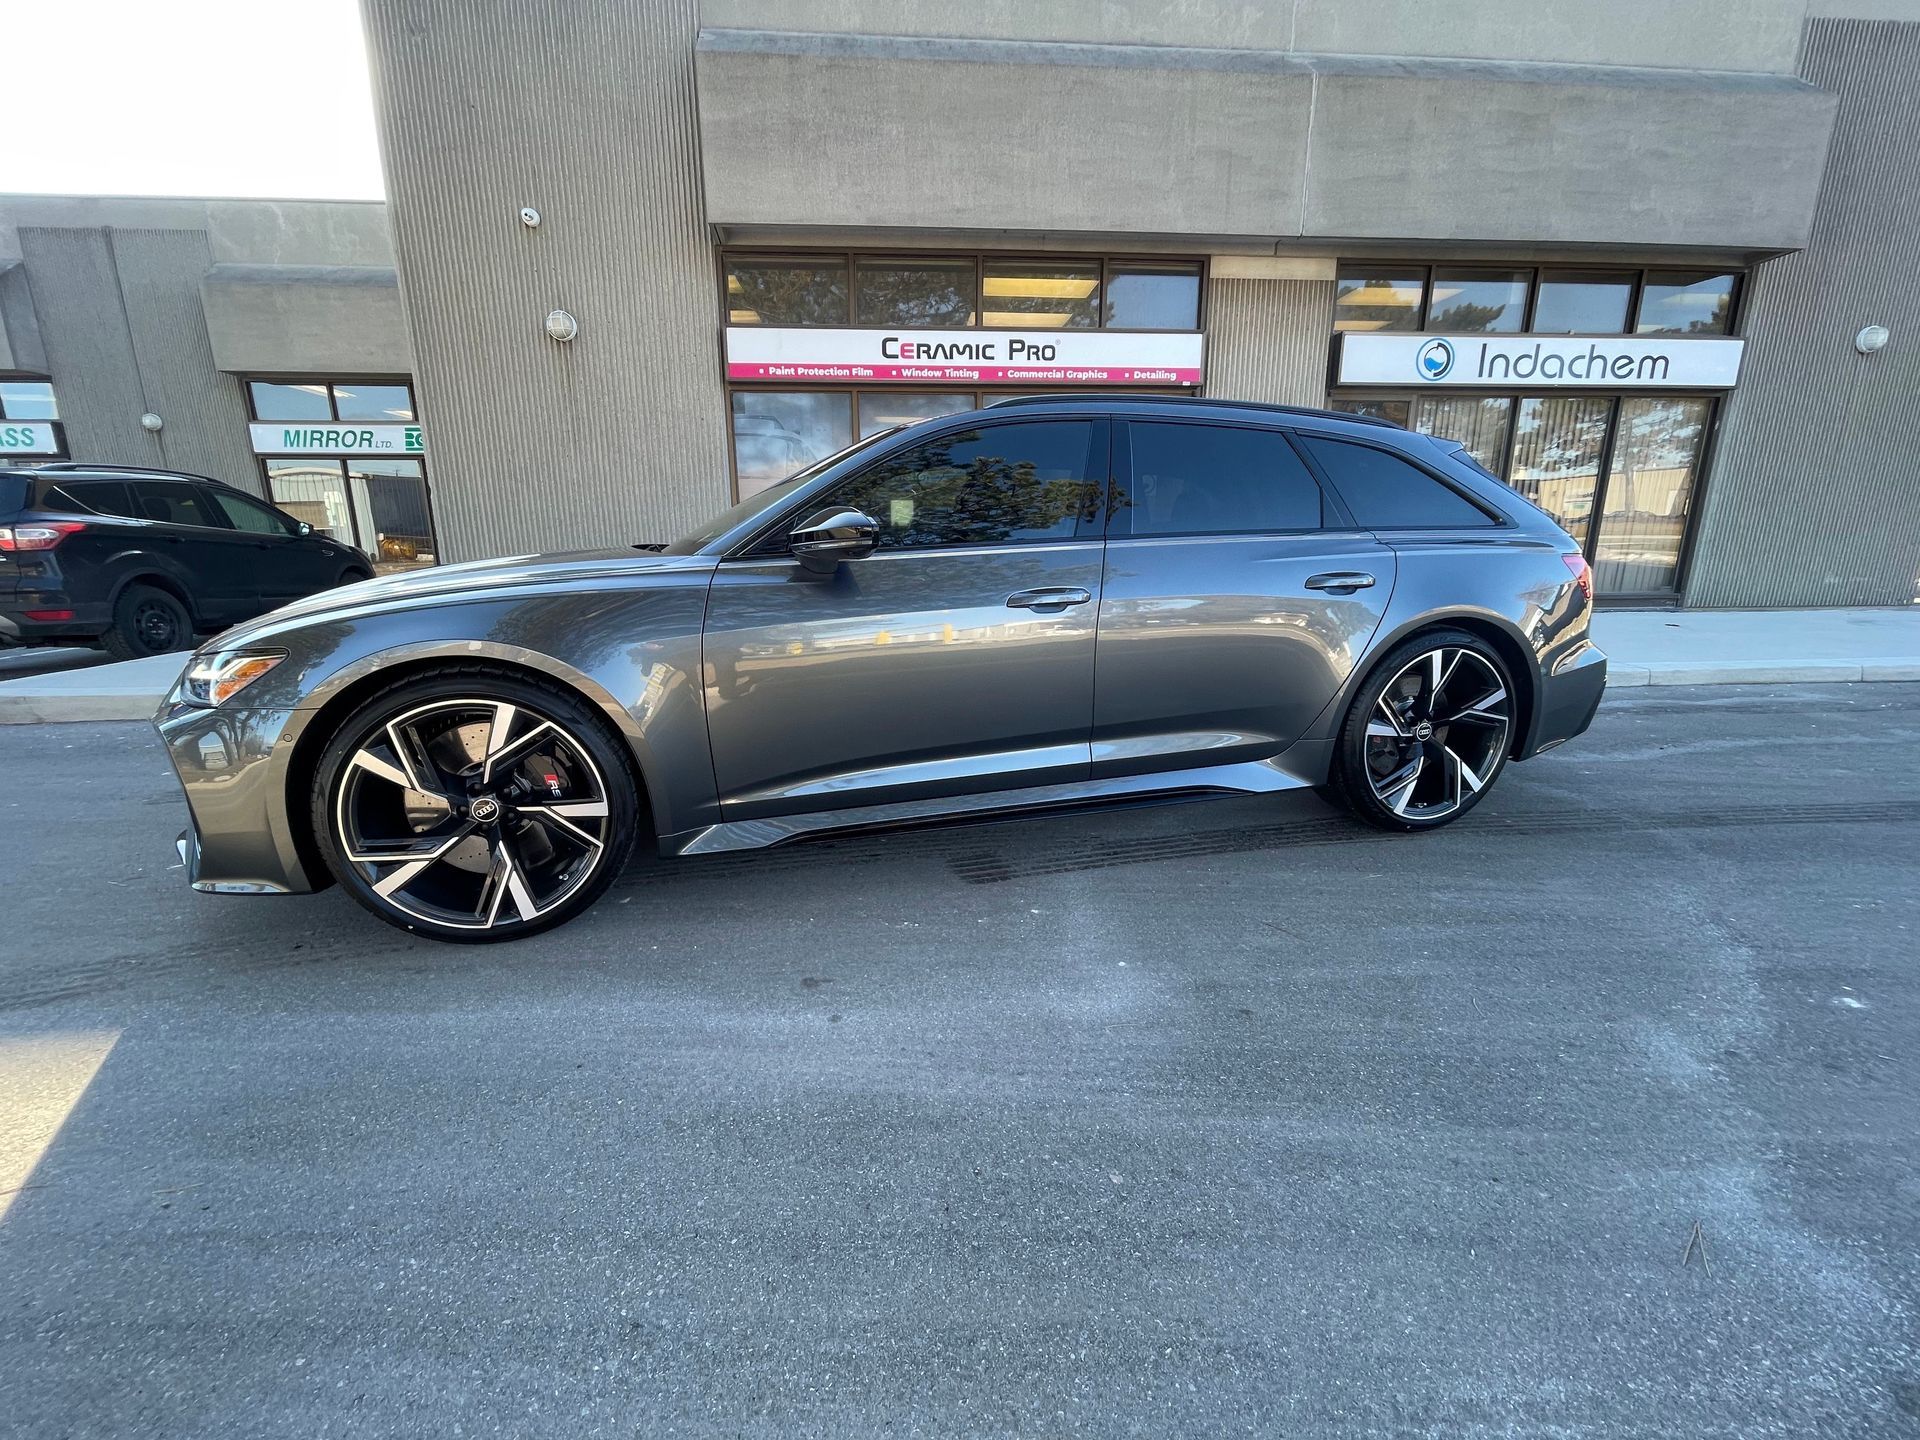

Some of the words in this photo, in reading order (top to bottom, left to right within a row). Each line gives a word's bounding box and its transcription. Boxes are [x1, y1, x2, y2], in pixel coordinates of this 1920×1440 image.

[881, 337, 995, 361] CERAMIC
[1478, 342, 1670, 380] Indachem
[768, 365, 796, 377] Paint
[797, 366, 850, 378] Protection
[851, 367, 874, 378] Film
[900, 368, 944, 379] Window
[945, 368, 980, 381] Tinting
[1007, 369, 1065, 380] Commercial
[1066, 369, 1108, 382] Graphics
[1133, 370, 1177, 382] Detailing
[283, 429, 374, 449] MIRROR
[375, 440, 395, 449] LTD.
